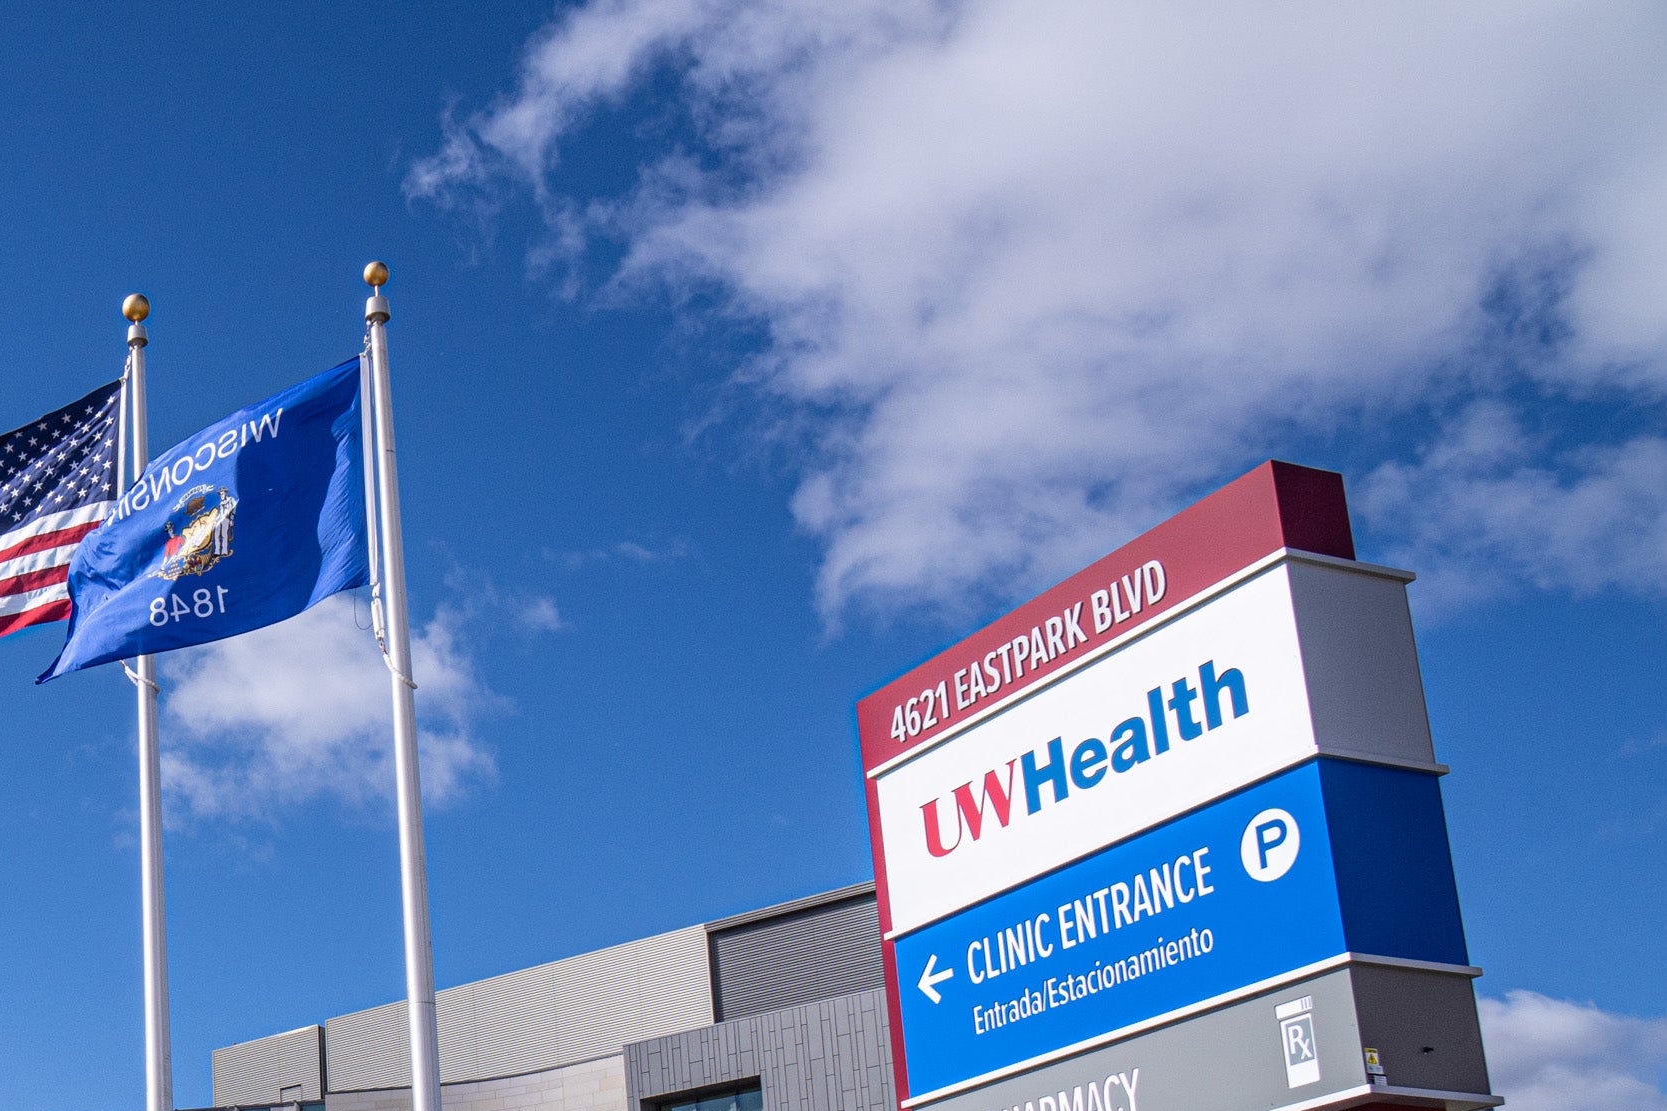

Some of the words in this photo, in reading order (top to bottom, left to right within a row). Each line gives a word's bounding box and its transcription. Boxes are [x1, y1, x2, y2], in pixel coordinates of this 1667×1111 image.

[890, 680, 949, 742] 4621
[953, 601, 1088, 711] EASTPARK
[1091, 560, 1166, 635] BLVD
[966, 912, 1054, 985] CLINIC
[1057, 846, 1214, 950] ENTRANCE
[972, 927, 1213, 1035] Entrada/Estacionamiento
